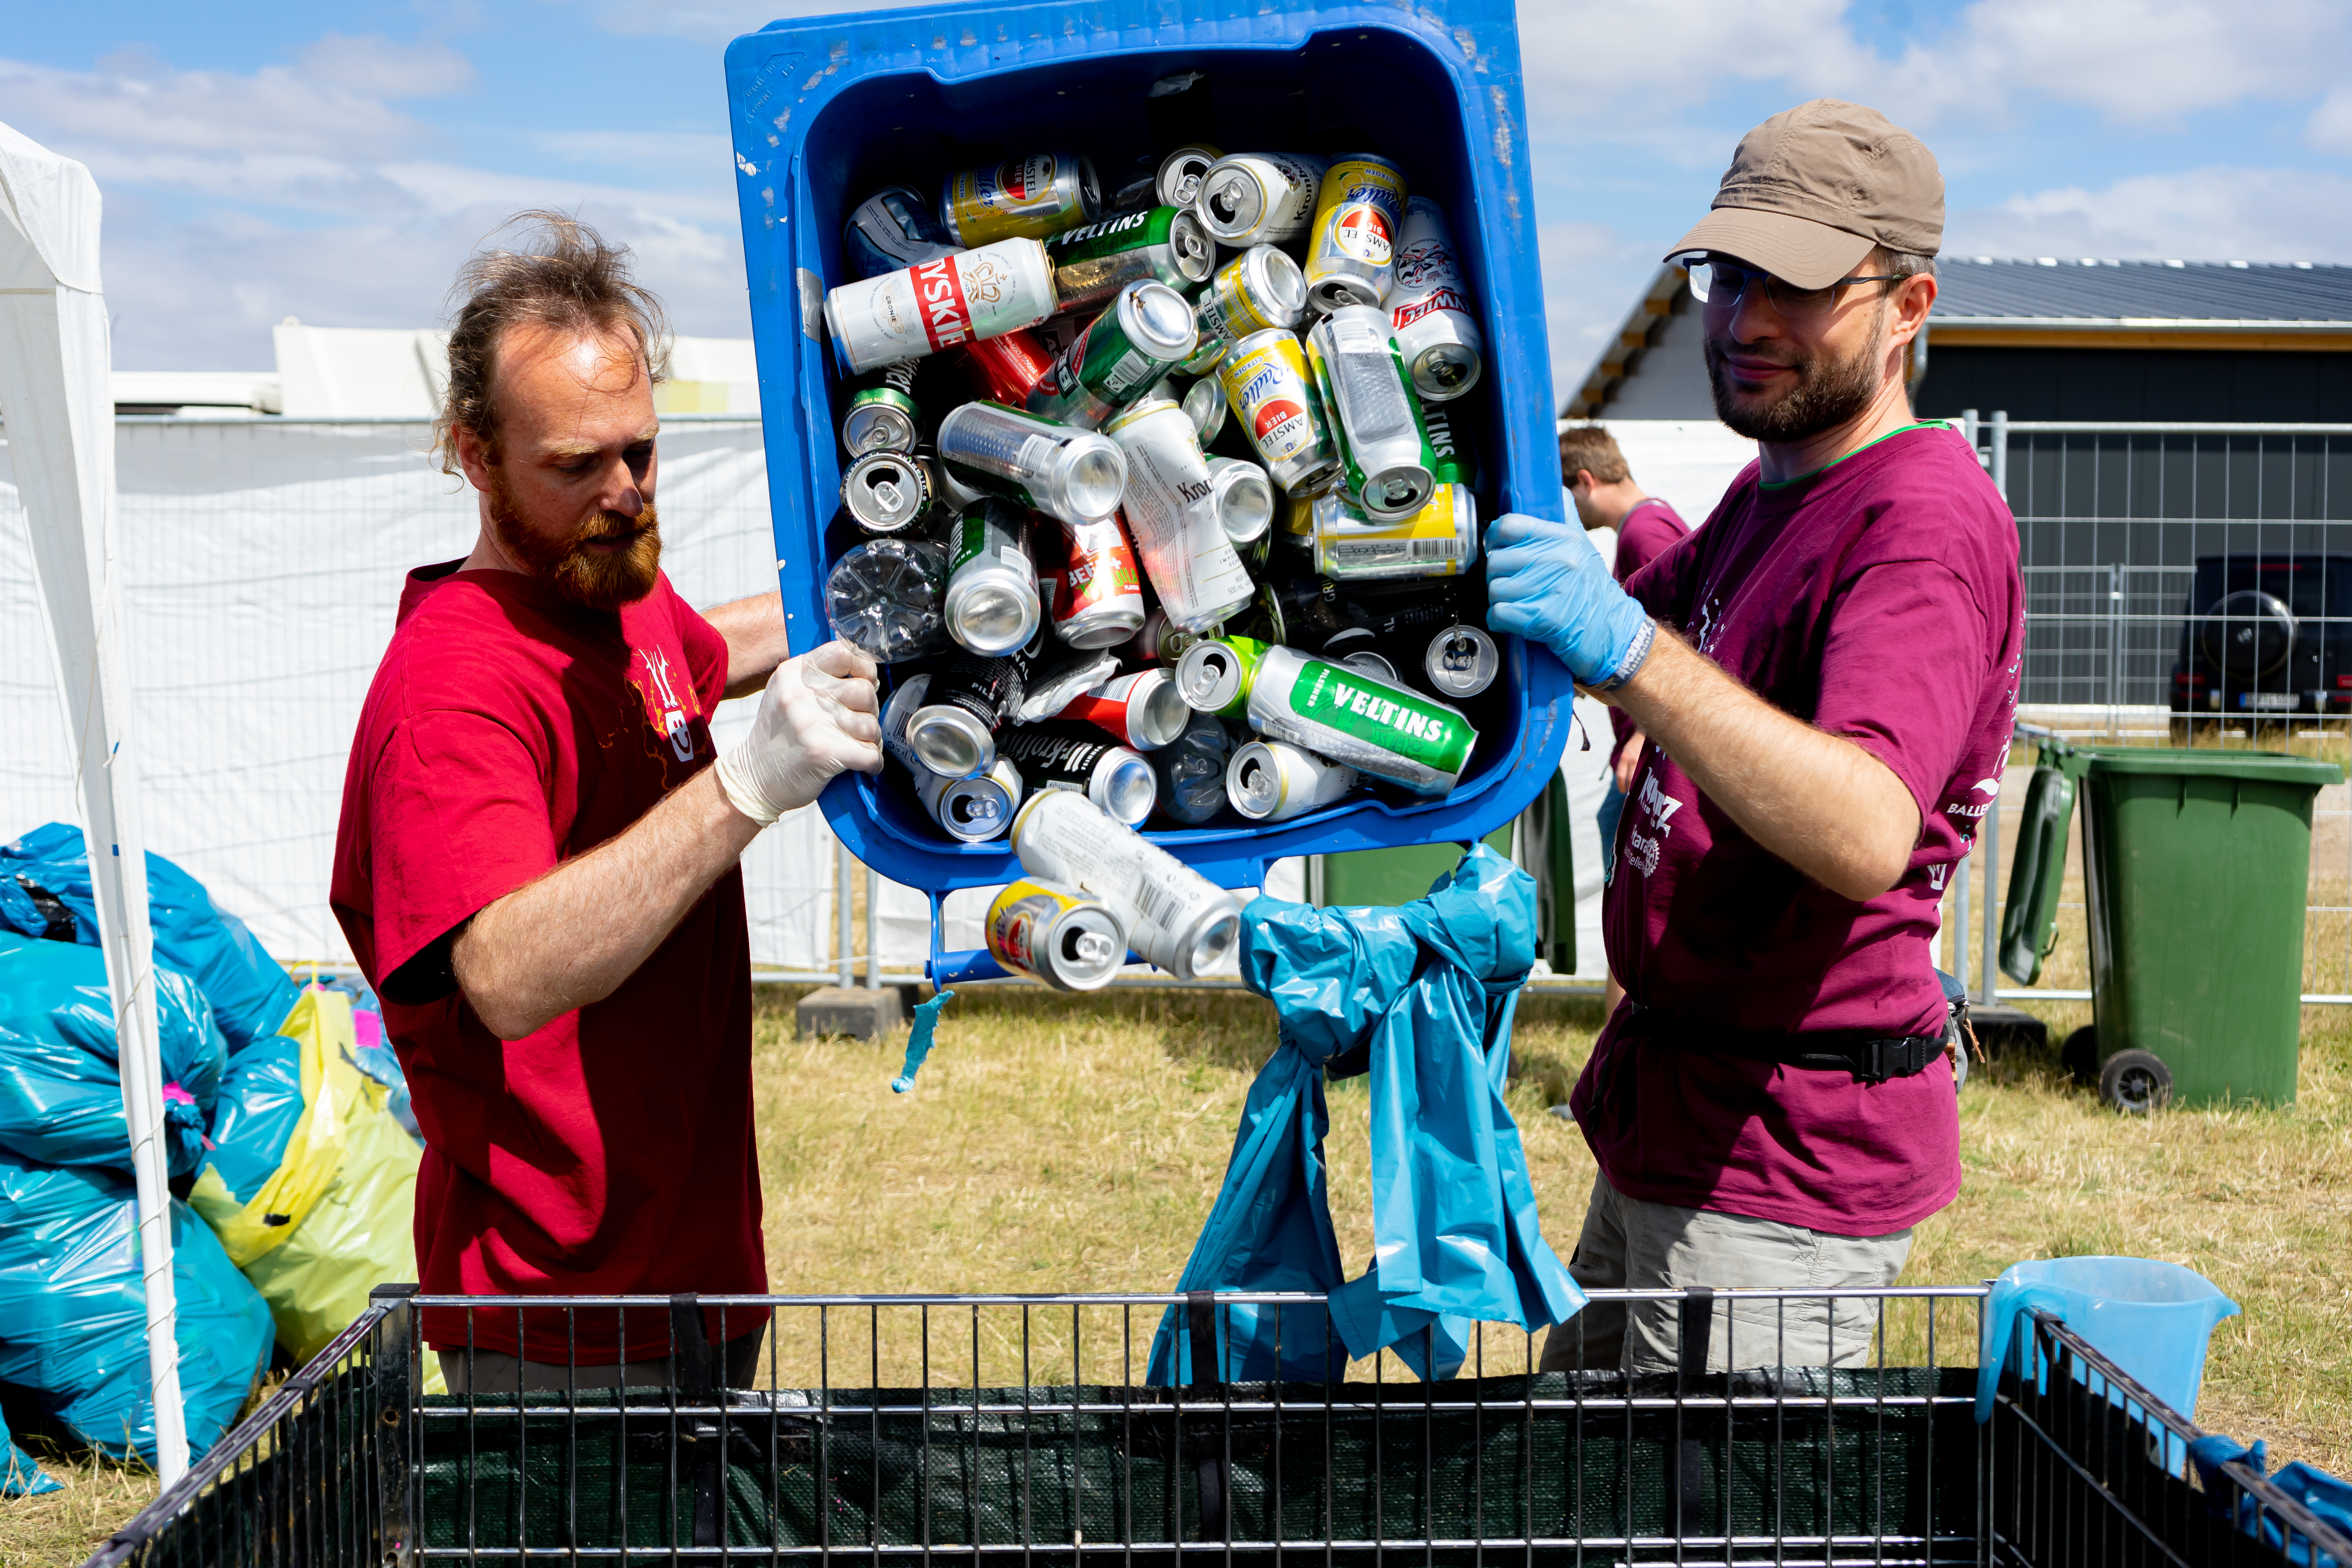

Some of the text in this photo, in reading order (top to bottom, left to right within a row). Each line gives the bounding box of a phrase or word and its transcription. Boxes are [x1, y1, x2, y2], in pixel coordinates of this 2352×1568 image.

[1014, 164, 1022, 183] BIER
[1025, 155, 1036, 195] AMSTEL
[1365, 169, 1396, 184] CITROEN
[1346, 186, 1408, 212] Radler
[1062, 211, 1148, 245] VELTINS
[1345, 229, 1390, 251] AMSEL
[1360, 221, 1382, 235] BIE
[885, 295, 898, 323] GRONIE
[918, 257, 967, 348] TYSKIE
[1205, 299, 1233, 340] AMSTEL
[1234, 356, 1263, 378] CITROEN
[1237, 357, 1290, 412] Radler
[1261, 416, 1303, 449] AMSTEL
[1265, 410, 1288, 429] BIER
[1421, 401, 1456, 459] LTINS
[1076, 567, 1138, 598] TUILA
[1227, 586, 1238, 596] 500
[971, 682, 995, 701] PILS
[1307, 668, 1330, 707] PILSENER
[1334, 682, 1443, 742] VELTINS
